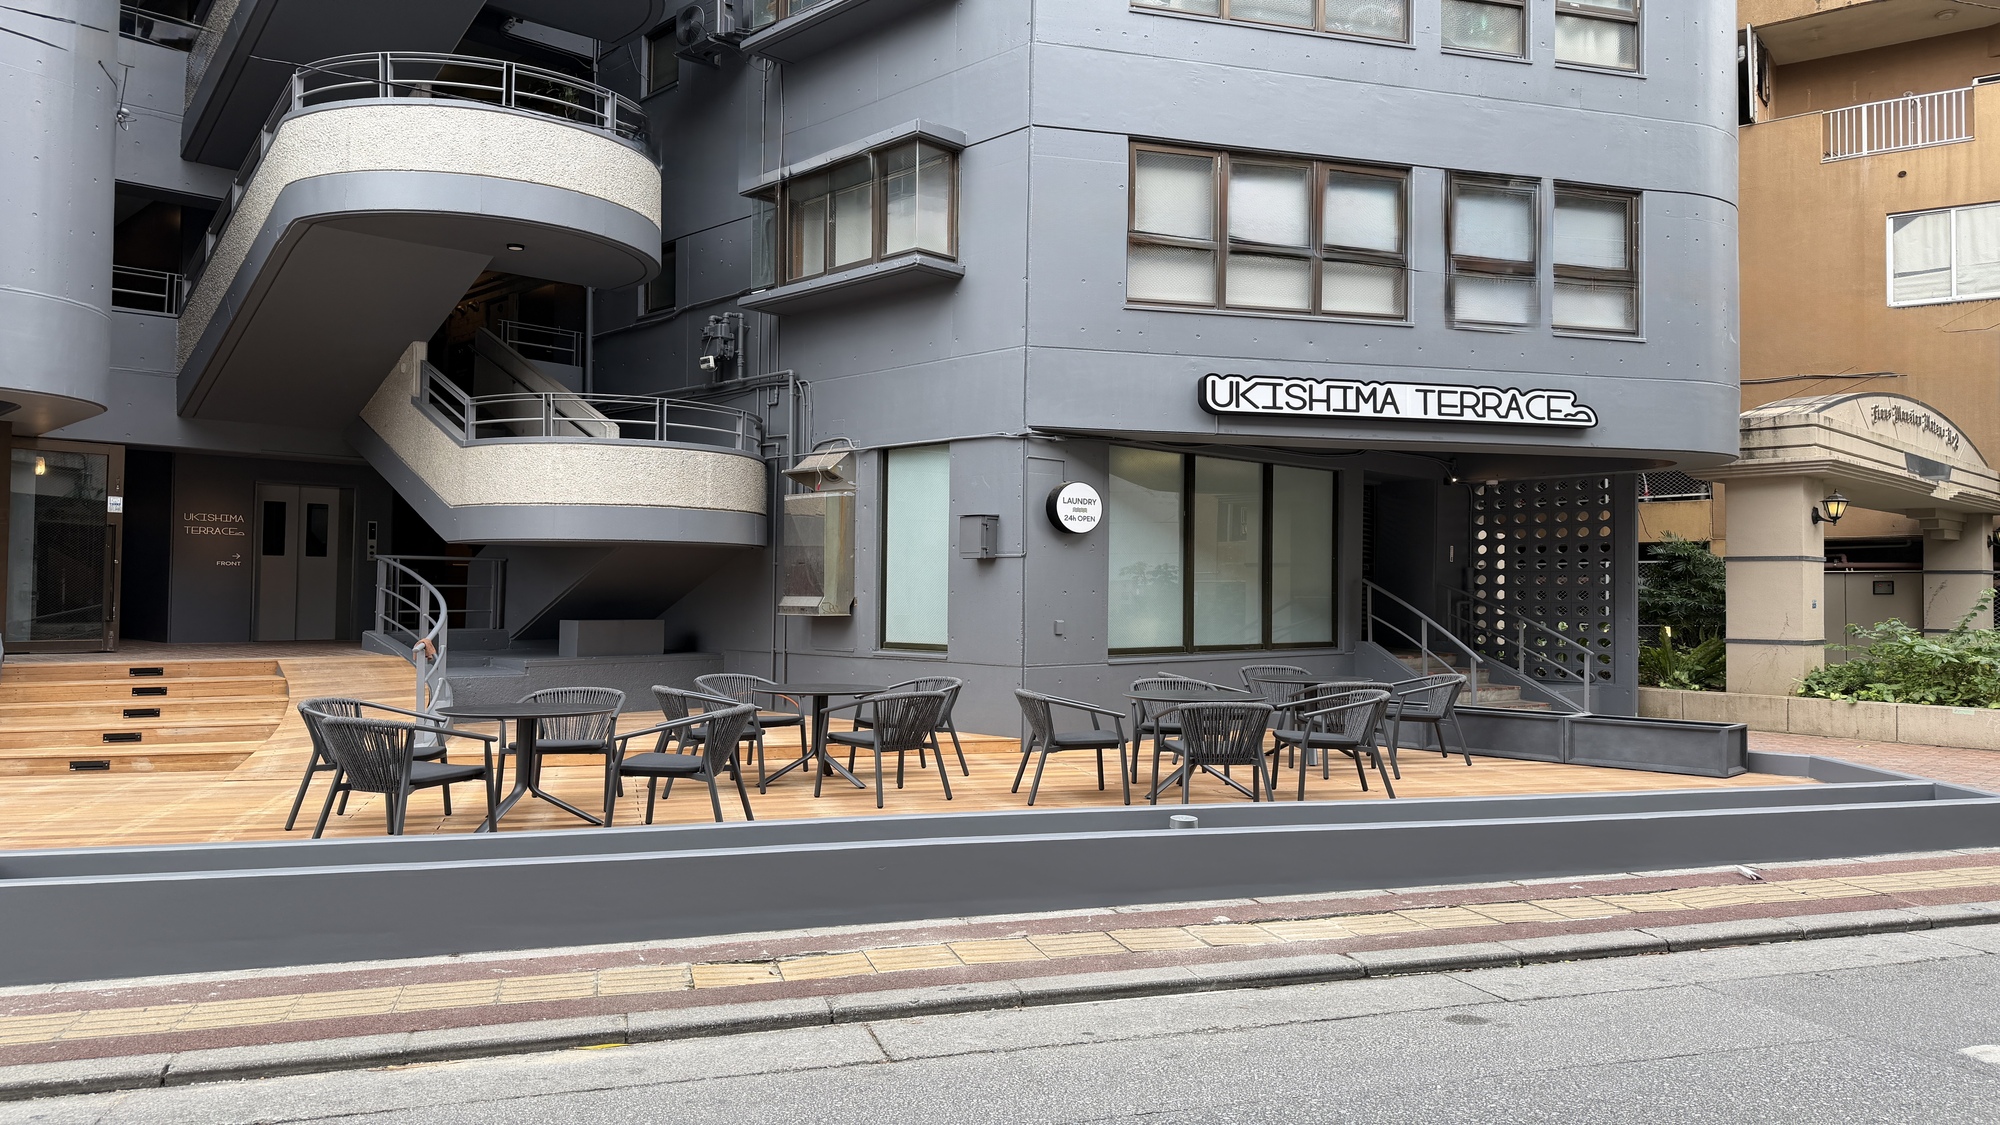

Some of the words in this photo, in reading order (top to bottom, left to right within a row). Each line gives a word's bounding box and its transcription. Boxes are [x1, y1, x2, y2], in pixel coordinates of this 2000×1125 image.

[1211, 379, 1401, 415] UKISHIMA
[1415, 388, 1572, 421] TERRACE
[1062, 496, 1097, 506] LAUNDRY
[183, 512, 244, 523] UKISHIMA
[1063, 514, 1077, 522] 24h
[183, 525, 238, 536] TERRACE
